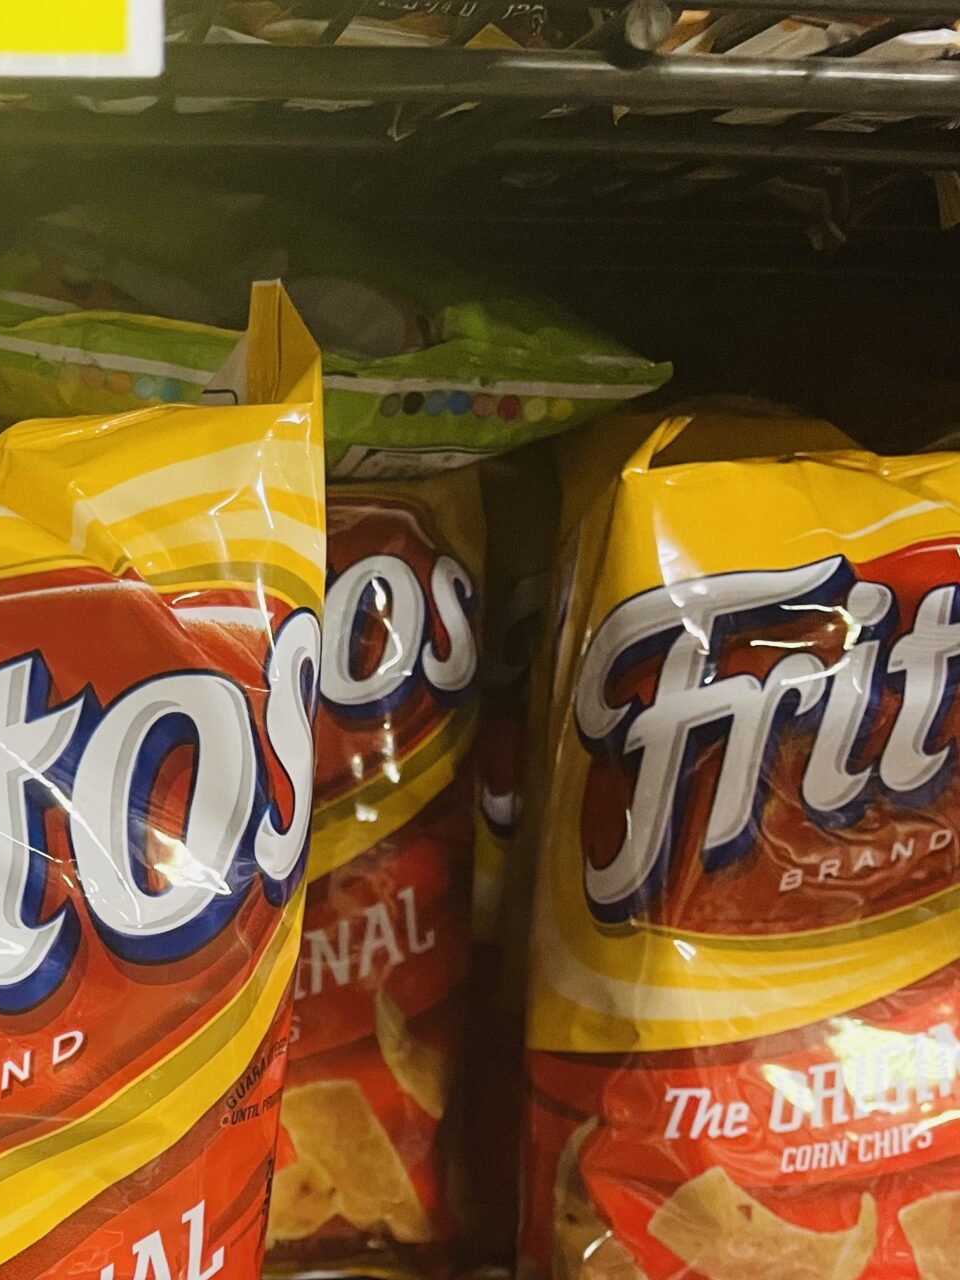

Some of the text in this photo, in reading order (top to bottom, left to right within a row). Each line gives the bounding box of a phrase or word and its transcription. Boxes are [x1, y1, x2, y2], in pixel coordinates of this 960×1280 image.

[574, 554, 960, 910] Frit
[779, 829, 953, 893] BRAND
[663, 1086, 751, 1141] The
[780, 1121, 934, 1174] CORN CHIPS
